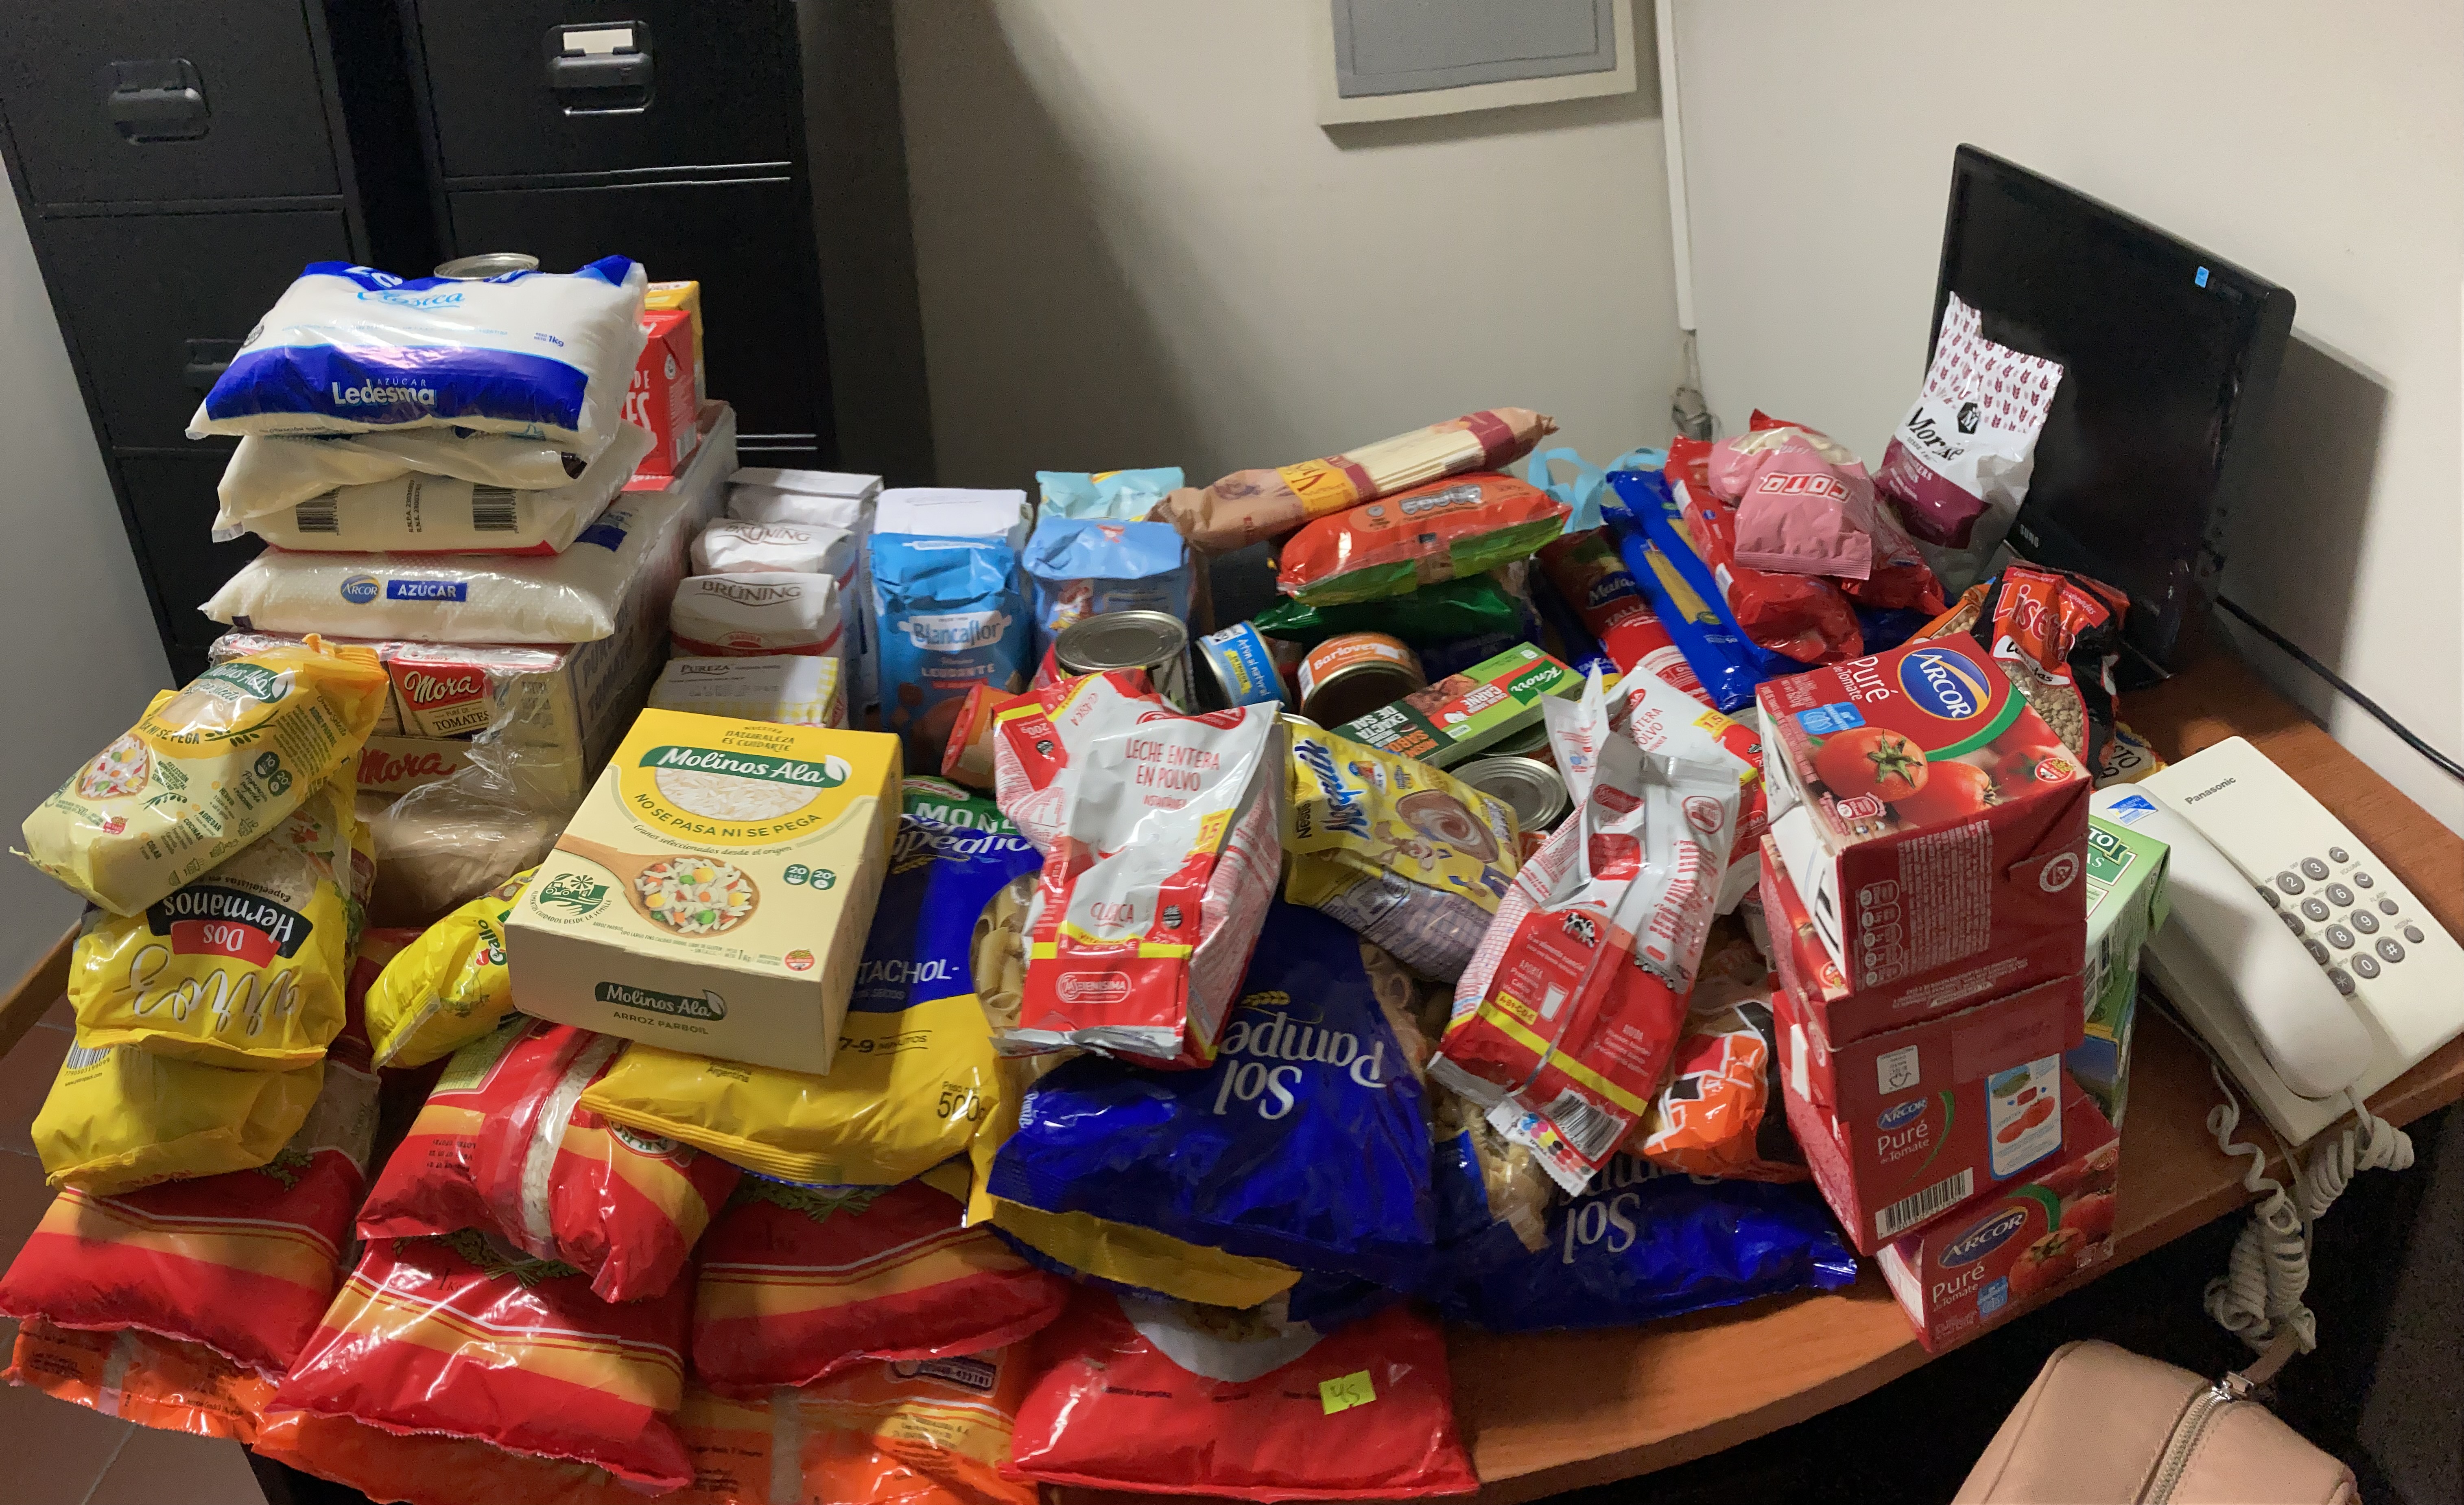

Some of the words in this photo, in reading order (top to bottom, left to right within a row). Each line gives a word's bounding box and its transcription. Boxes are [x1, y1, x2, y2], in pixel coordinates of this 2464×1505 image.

[548, 335, 565, 347] 1kg
[332, 379, 435, 405] Ledesma
[342, 583, 377, 596] ARCOR
[398, 581, 457, 597] AZÚCAR
[701, 580, 801, 601] BRÜNING
[913, 619, 1000, 644] Blancaflor
[681, 664, 730, 673] PUREZA
[1510, 665, 1563, 692] Knorr
[1846, 656, 1890, 703] Puré
[403, 671, 481, 704] Mora
[1460, 682, 1502, 711] CARNE
[1837, 669, 1863, 701] Tomate
[1912, 653, 1972, 719] ARCOR
[1346, 711, 1378, 734] SAL
[1374, 702, 1398, 722] DE
[170, 732, 200, 744] PEGA
[725, 731, 795, 744] NATURALEZA
[1356, 709, 1408, 744] EXACTA
[1635, 721, 1665, 747] OLVO
[737, 740, 791, 752] CUIDARTE
[1386, 726, 1429, 756] SABO
[265, 754, 276, 768] 10
[656, 747, 767, 775] Molinos
[768, 762, 825, 783] Ala
[1125, 737, 1164, 762] LECHE
[1166, 745, 1220, 770] ENTERA
[157, 760, 187, 791] MONOVARIETAL
[166, 761, 190, 783] SELECCIÓN
[356, 748, 457, 785] Mora
[1136, 765, 1156, 787] EN
[1156, 767, 1201, 792] POLVO
[218, 787, 235, 807] HERVIR
[2185, 777, 2237, 805] Panasonic
[634, 793, 655, 809] NO
[651, 808, 673, 822] SE
[670, 818, 716, 836] PASA
[721, 828, 742, 837] NI
[746, 827, 770, 837] SE
[773, 814, 822, 834] PEGA
[915, 802, 1018, 833] MON
[183, 818, 204, 841] COCINAR
[633, 824, 660, 840] Granos
[658, 836, 720, 855] seleccionados
[721, 847, 749, 855] desde
[762, 846, 792, 856] origen
[788, 866, 807, 875] 20
[2310, 862, 2321, 873] 3
[2339, 860, 2362, 875] VOLUME
[2286, 877, 2298, 887] 2
[2336, 888, 2347, 899] 6
[530, 890, 539, 912] ALIMENTOS
[535, 910, 562, 924] CUIDADOS
[593, 900, 612, 917] SEMILLA
[2311, 903, 2322, 914] 5
[2369, 890, 2388, 903] FLASH
[164, 894, 295, 943] Hermanos
[2287, 919, 2296, 929] 4
[2361, 915, 2372, 926] 9
[203, 923, 245, 952] Dos
[478, 919, 507, 966] Gallo
[2336, 930, 2348, 942] 8
[2310, 946, 2320, 957] 7
[2385, 943, 2398, 956] #
[2361, 959, 2372, 971] 0
[606, 984, 675, 1012] Molinos
[676, 999, 712, 1017] Ala
[613, 1011, 655, 1026] ARROZ
[658, 1020, 709, 1035] PARBOIL
[839, 1036, 875, 1053] 7-9
[1221, 1012, 1387, 1088] Pampe
[64, 1057, 111, 1077] 7790503199099
[1213, 1059, 1303, 1120] Sol
[1881, 1098, 1927, 1124] ARCOR
[1877, 1120, 1929, 1156] Puré
[1889, 1139, 1930, 1162] Tomate
[1564, 1192, 1642, 1265] Sol
[1943, 1214, 2023, 1263] ARCOR
[1933, 1261, 1985, 1304] Puré
[1942, 1283, 1978, 1306] Tomate
